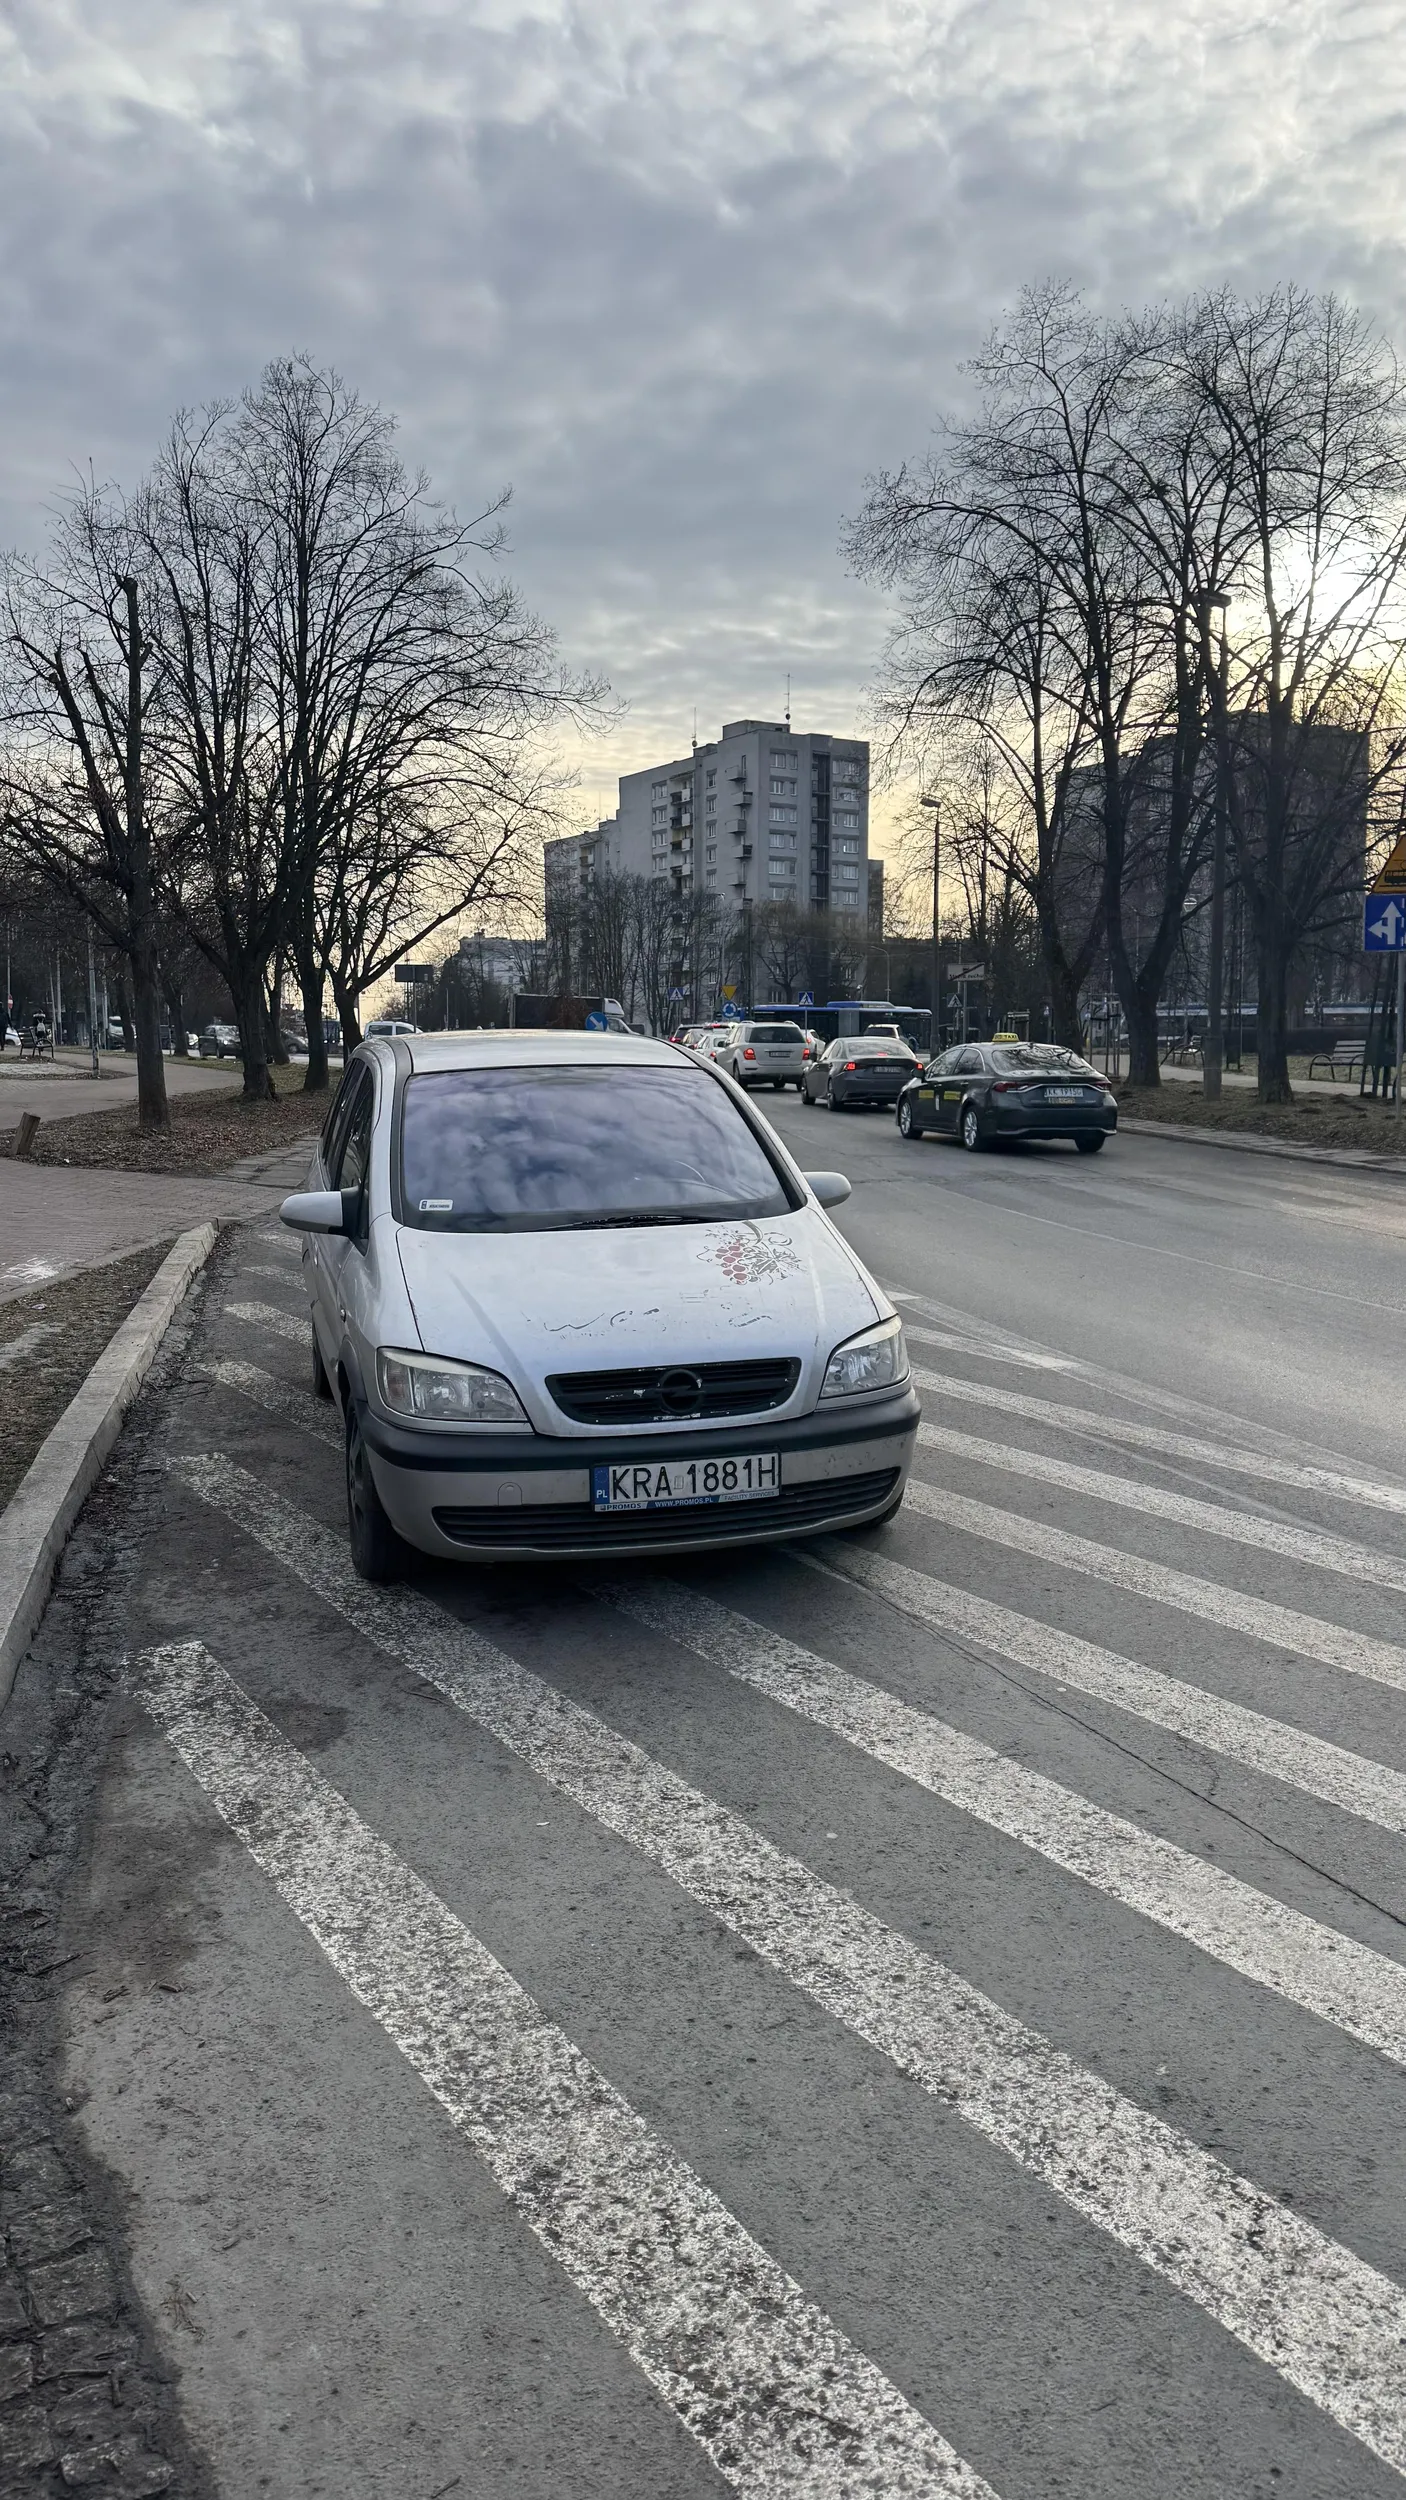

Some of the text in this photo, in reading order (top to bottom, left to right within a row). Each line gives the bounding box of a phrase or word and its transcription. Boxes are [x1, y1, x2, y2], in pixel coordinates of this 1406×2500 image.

[612, 1456, 776, 1501] KRA 1881H
[596, 1489, 608, 1499] PL
[606, 1502, 642, 1511] PROMOS
[654, 1497, 714, 1508] WWW.PROMOS.PL
